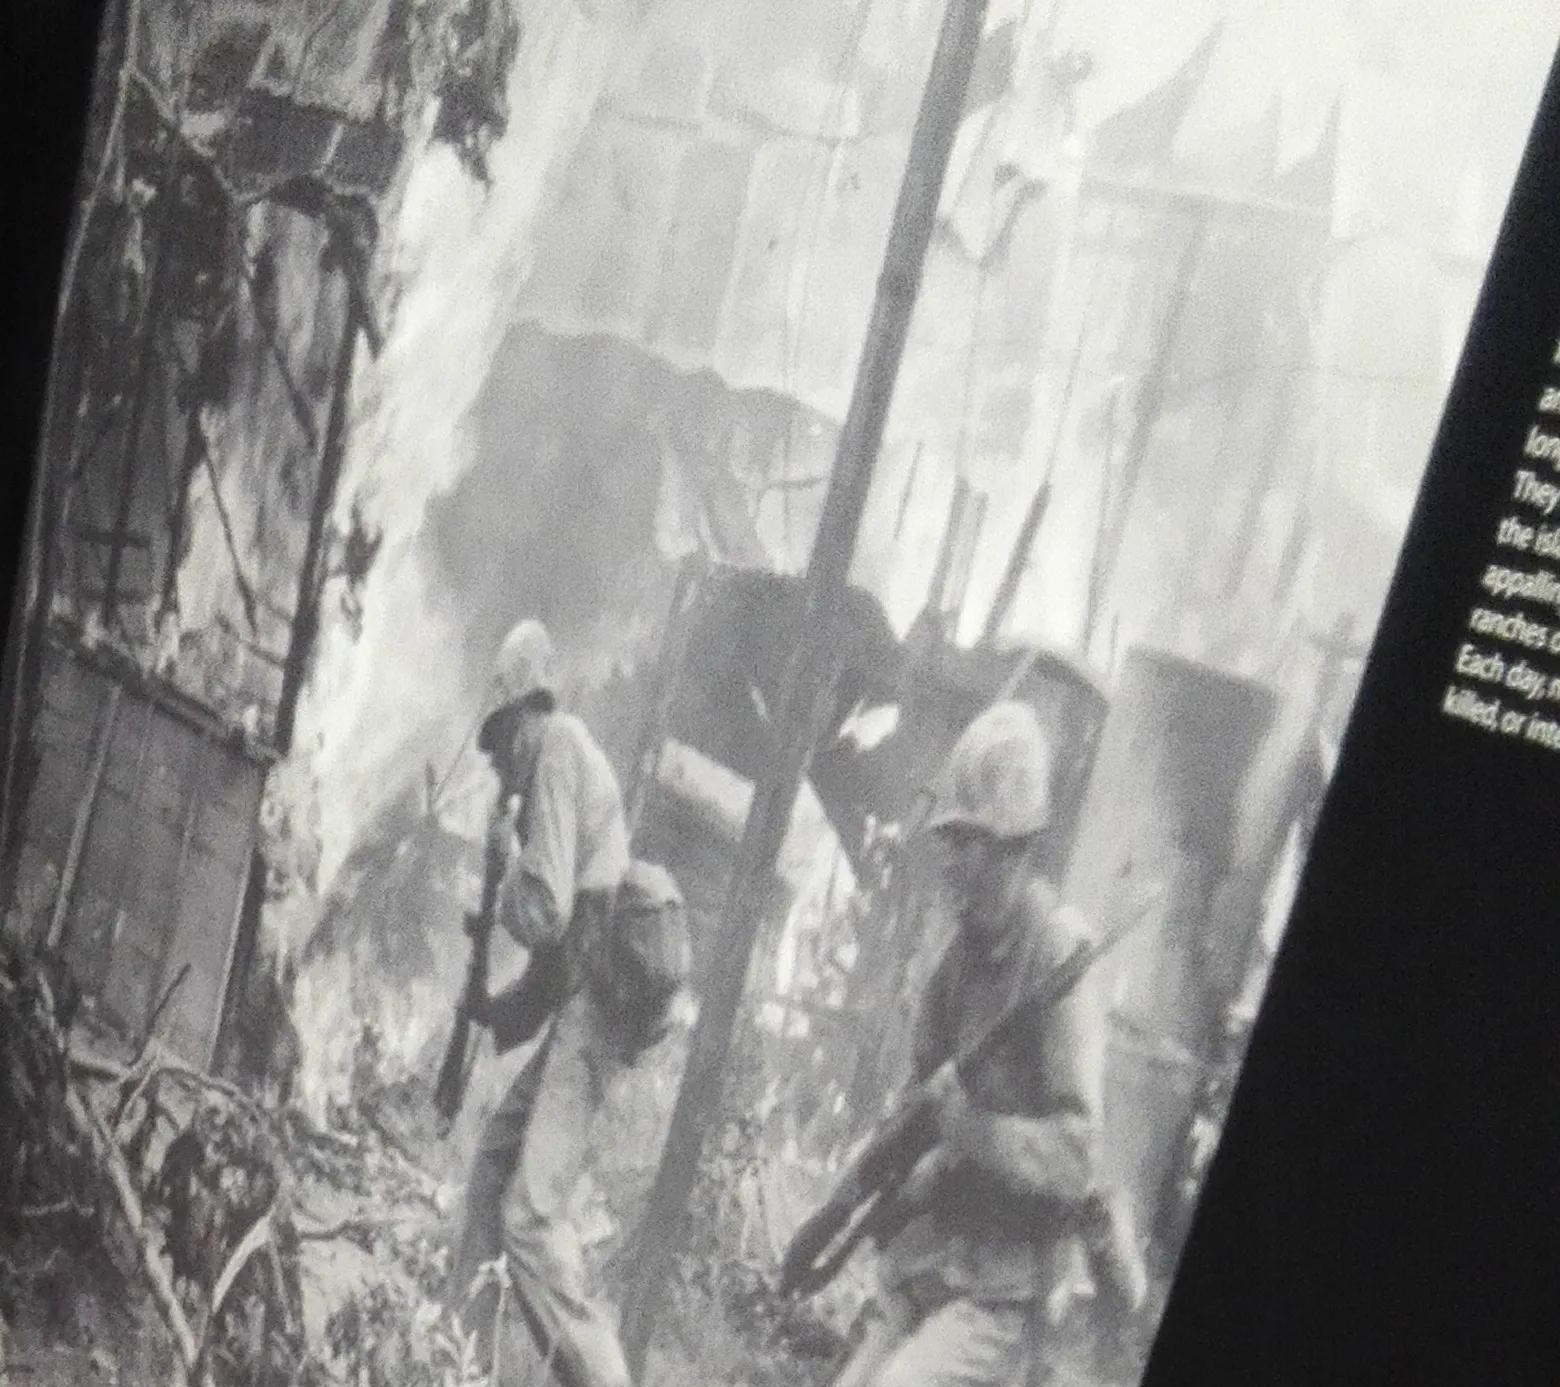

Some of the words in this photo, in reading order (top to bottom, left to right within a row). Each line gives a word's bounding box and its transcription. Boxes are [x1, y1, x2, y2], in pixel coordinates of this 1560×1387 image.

[1513, 469, 1560, 514] They
[1497, 516, 1534, 551] the
[1469, 607, 1548, 649] ranches
[1455, 643, 1504, 682] Each
[1505, 660, 1545, 700] day,
[1500, 710, 1528, 735] or
